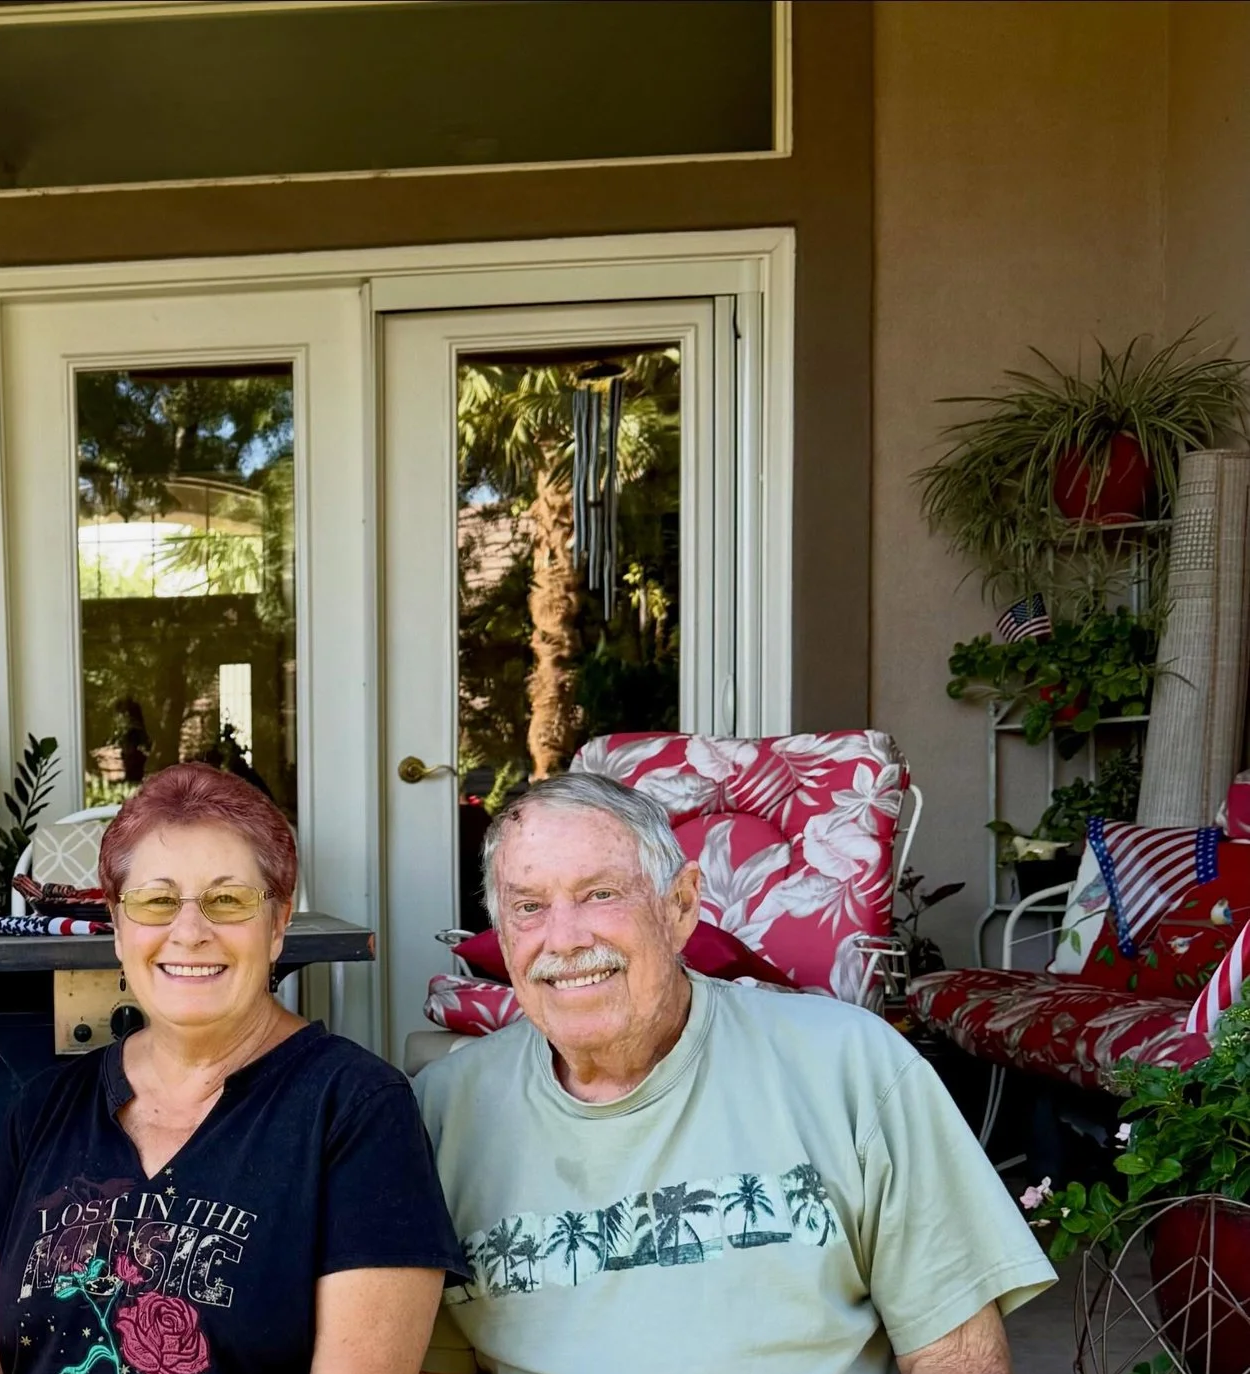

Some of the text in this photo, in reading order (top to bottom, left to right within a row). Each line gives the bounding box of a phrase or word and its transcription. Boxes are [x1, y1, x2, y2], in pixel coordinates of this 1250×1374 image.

[38, 1192, 258, 1240] LOST IN THE
[17, 1219, 243, 1308] MUSIC
